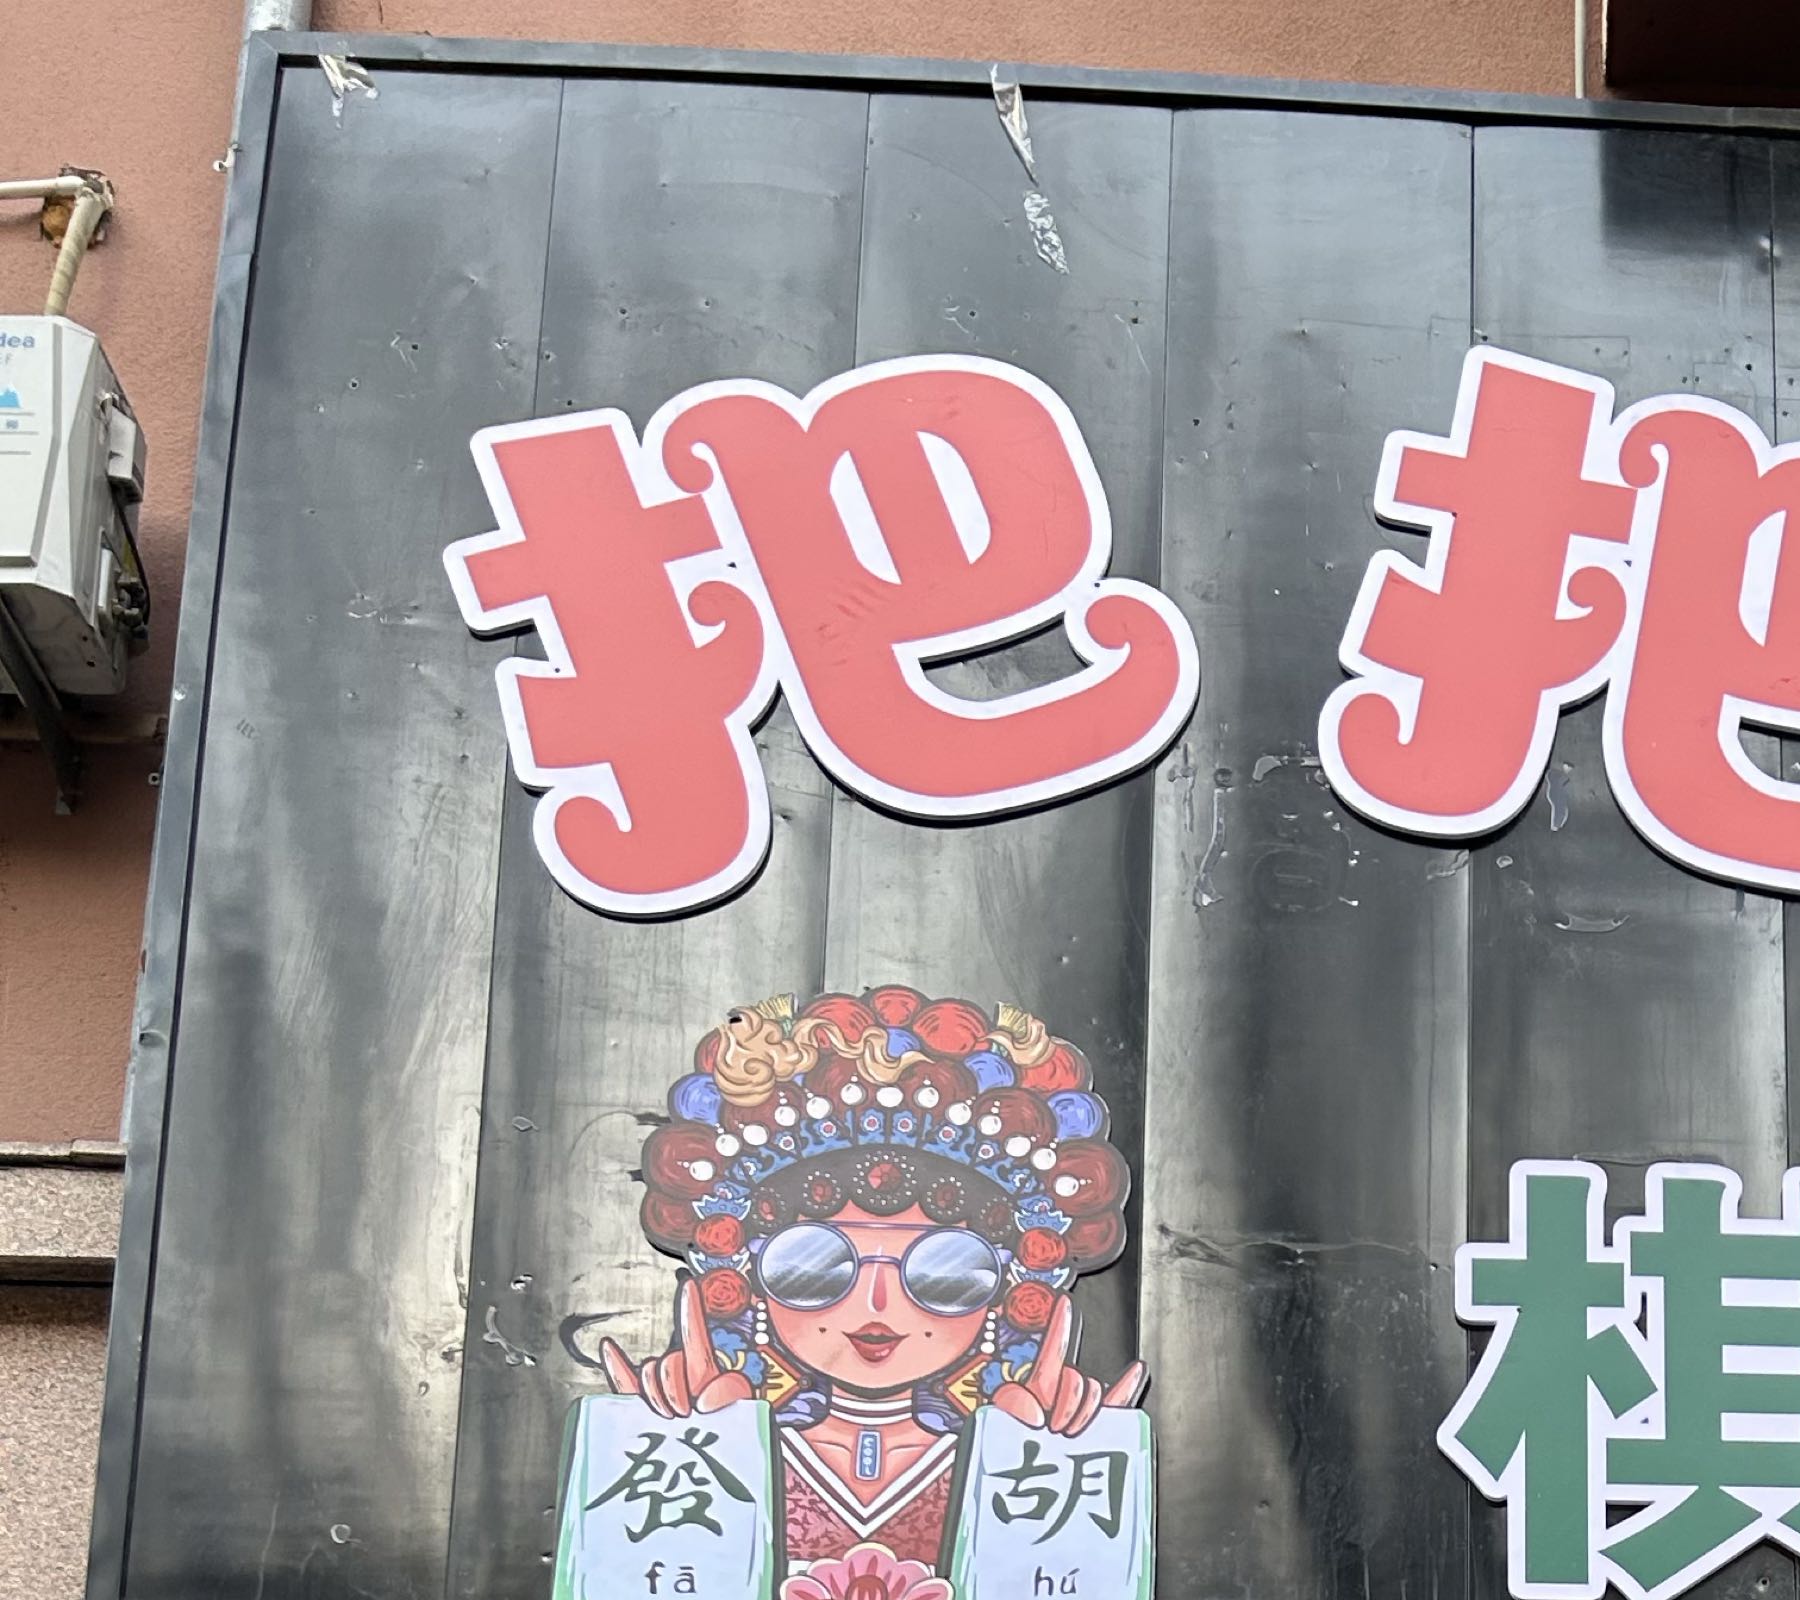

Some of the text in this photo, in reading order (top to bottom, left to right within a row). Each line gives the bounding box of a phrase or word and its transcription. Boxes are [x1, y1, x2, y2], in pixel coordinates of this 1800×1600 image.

[584, 1428, 756, 1542] 發
[990, 1440, 1128, 1545] 胡
[1034, 1565, 1080, 1597] hú
